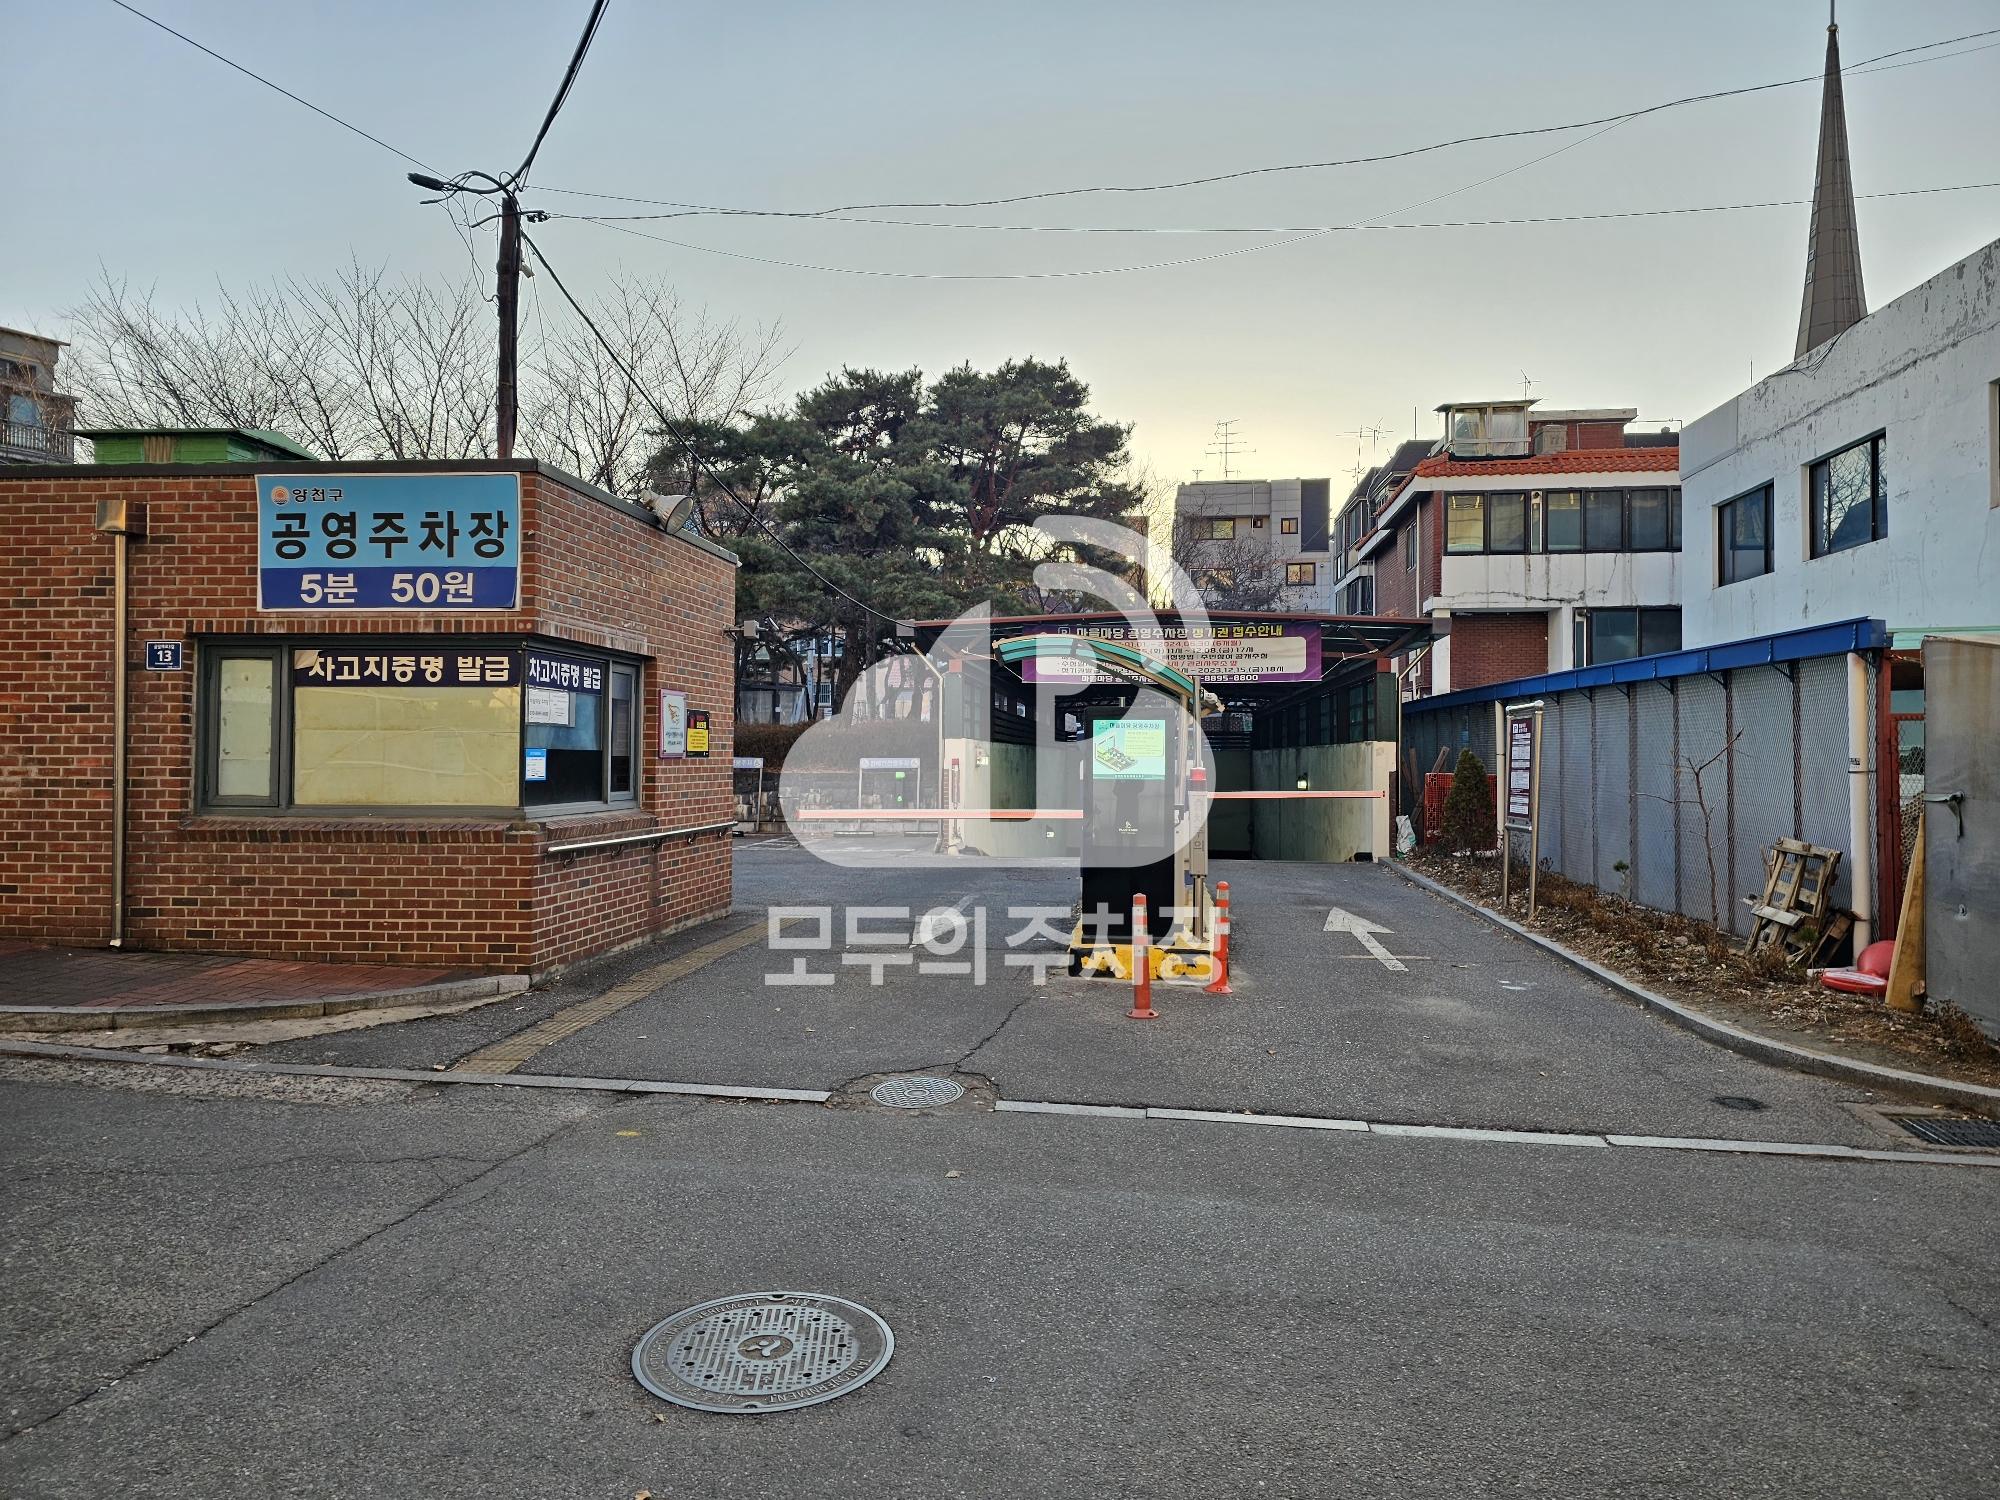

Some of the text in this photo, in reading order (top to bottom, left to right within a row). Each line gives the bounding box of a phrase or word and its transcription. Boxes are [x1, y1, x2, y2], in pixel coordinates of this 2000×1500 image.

[292, 487, 343, 502] 양천구
[271, 510, 509, 560] 공영주차장
[300, 571, 474, 604] 5분 50원
[1128, 628, 1188, 639] 공영주차장
[1192, 626, 1229, 638] 정기권
[1232, 624, 1283, 637] 접수안내
[156, 649, 172, 662] 13
[308, 656, 510, 682] 차고지증명 발급
[529, 657, 601, 690] 차고지증명 발급
